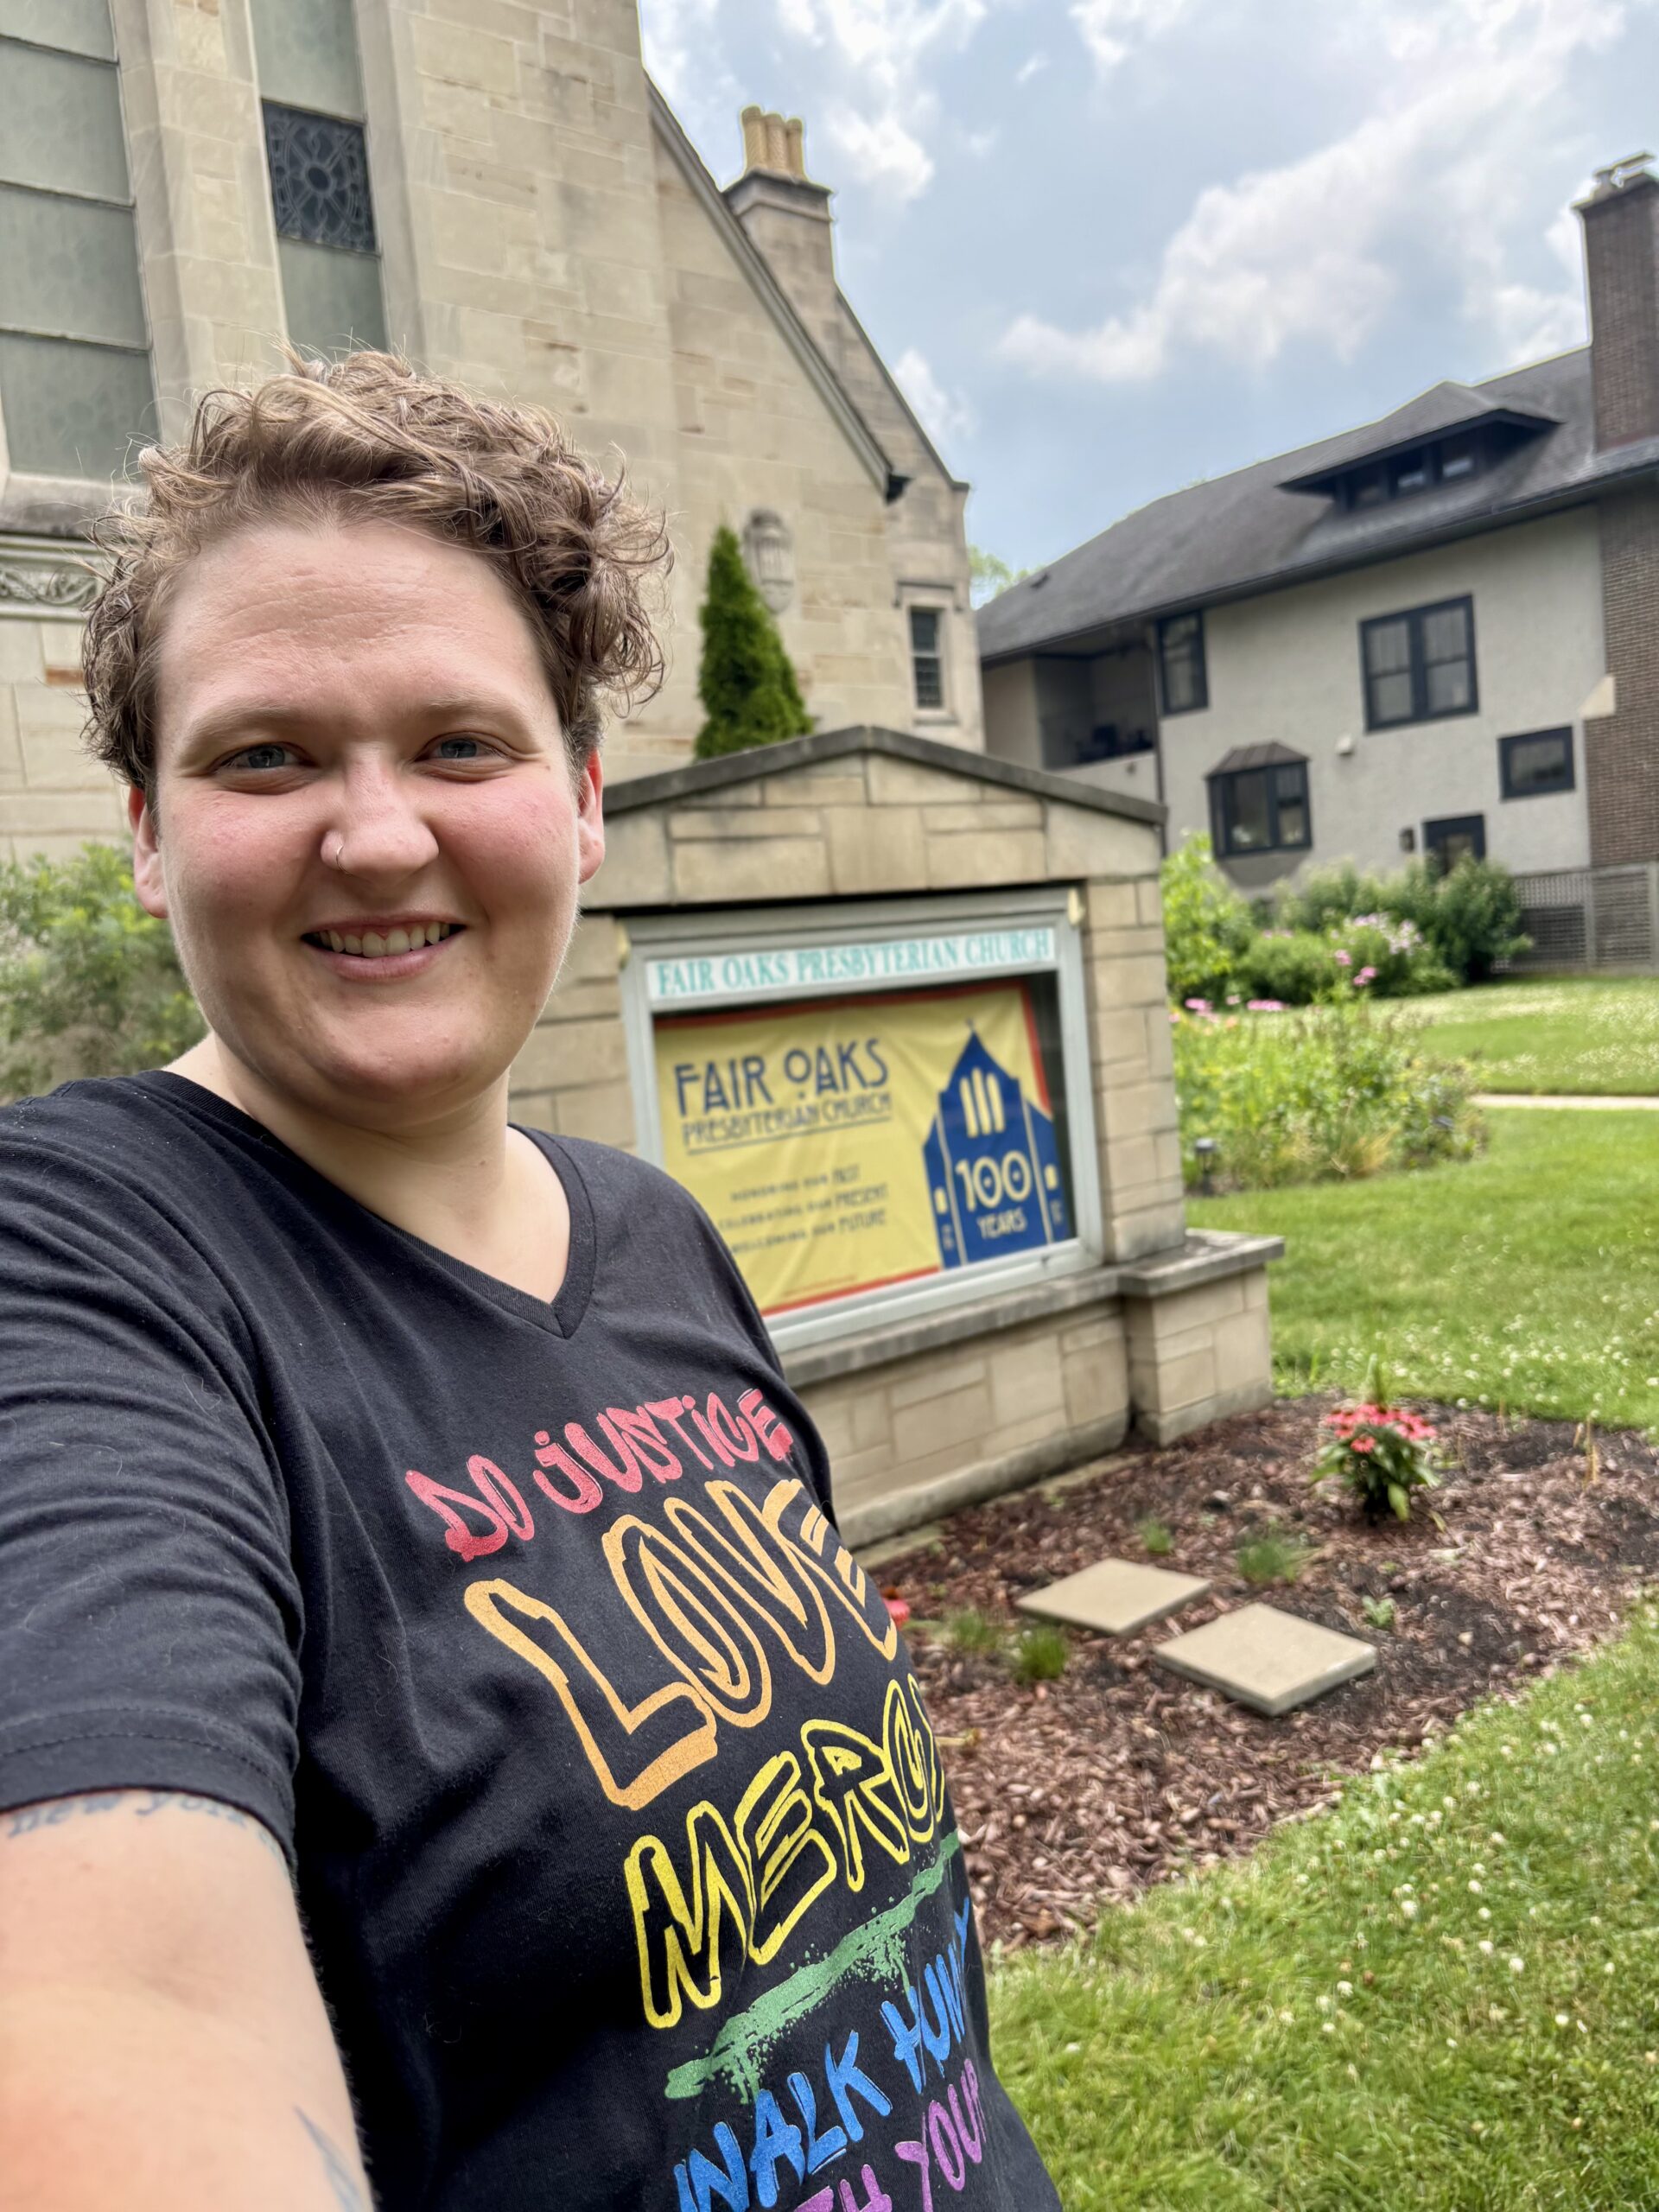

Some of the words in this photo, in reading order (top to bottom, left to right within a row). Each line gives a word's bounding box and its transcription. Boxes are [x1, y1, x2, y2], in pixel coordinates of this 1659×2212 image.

[656, 960, 716, 995] FAIR
[722, 955, 790, 988] OAKS
[796, 941, 960, 983] PRESBYTERIAN
[964, 928, 1052, 963] CHURCH
[674, 1055, 773, 1117] FAIR
[783, 1038, 889, 1099] OAKS
[682, 1104, 821, 1146] PRESBYTERIAN
[822, 1092, 892, 1122] CHURCH
[955, 1150, 1033, 1212] 100
[976, 1207, 1027, 1239] YEARS
[405, 1454, 534, 1561] DO
[464, 1478, 897, 1810] LOVE
[674, 2031, 893, 2212] WALK
